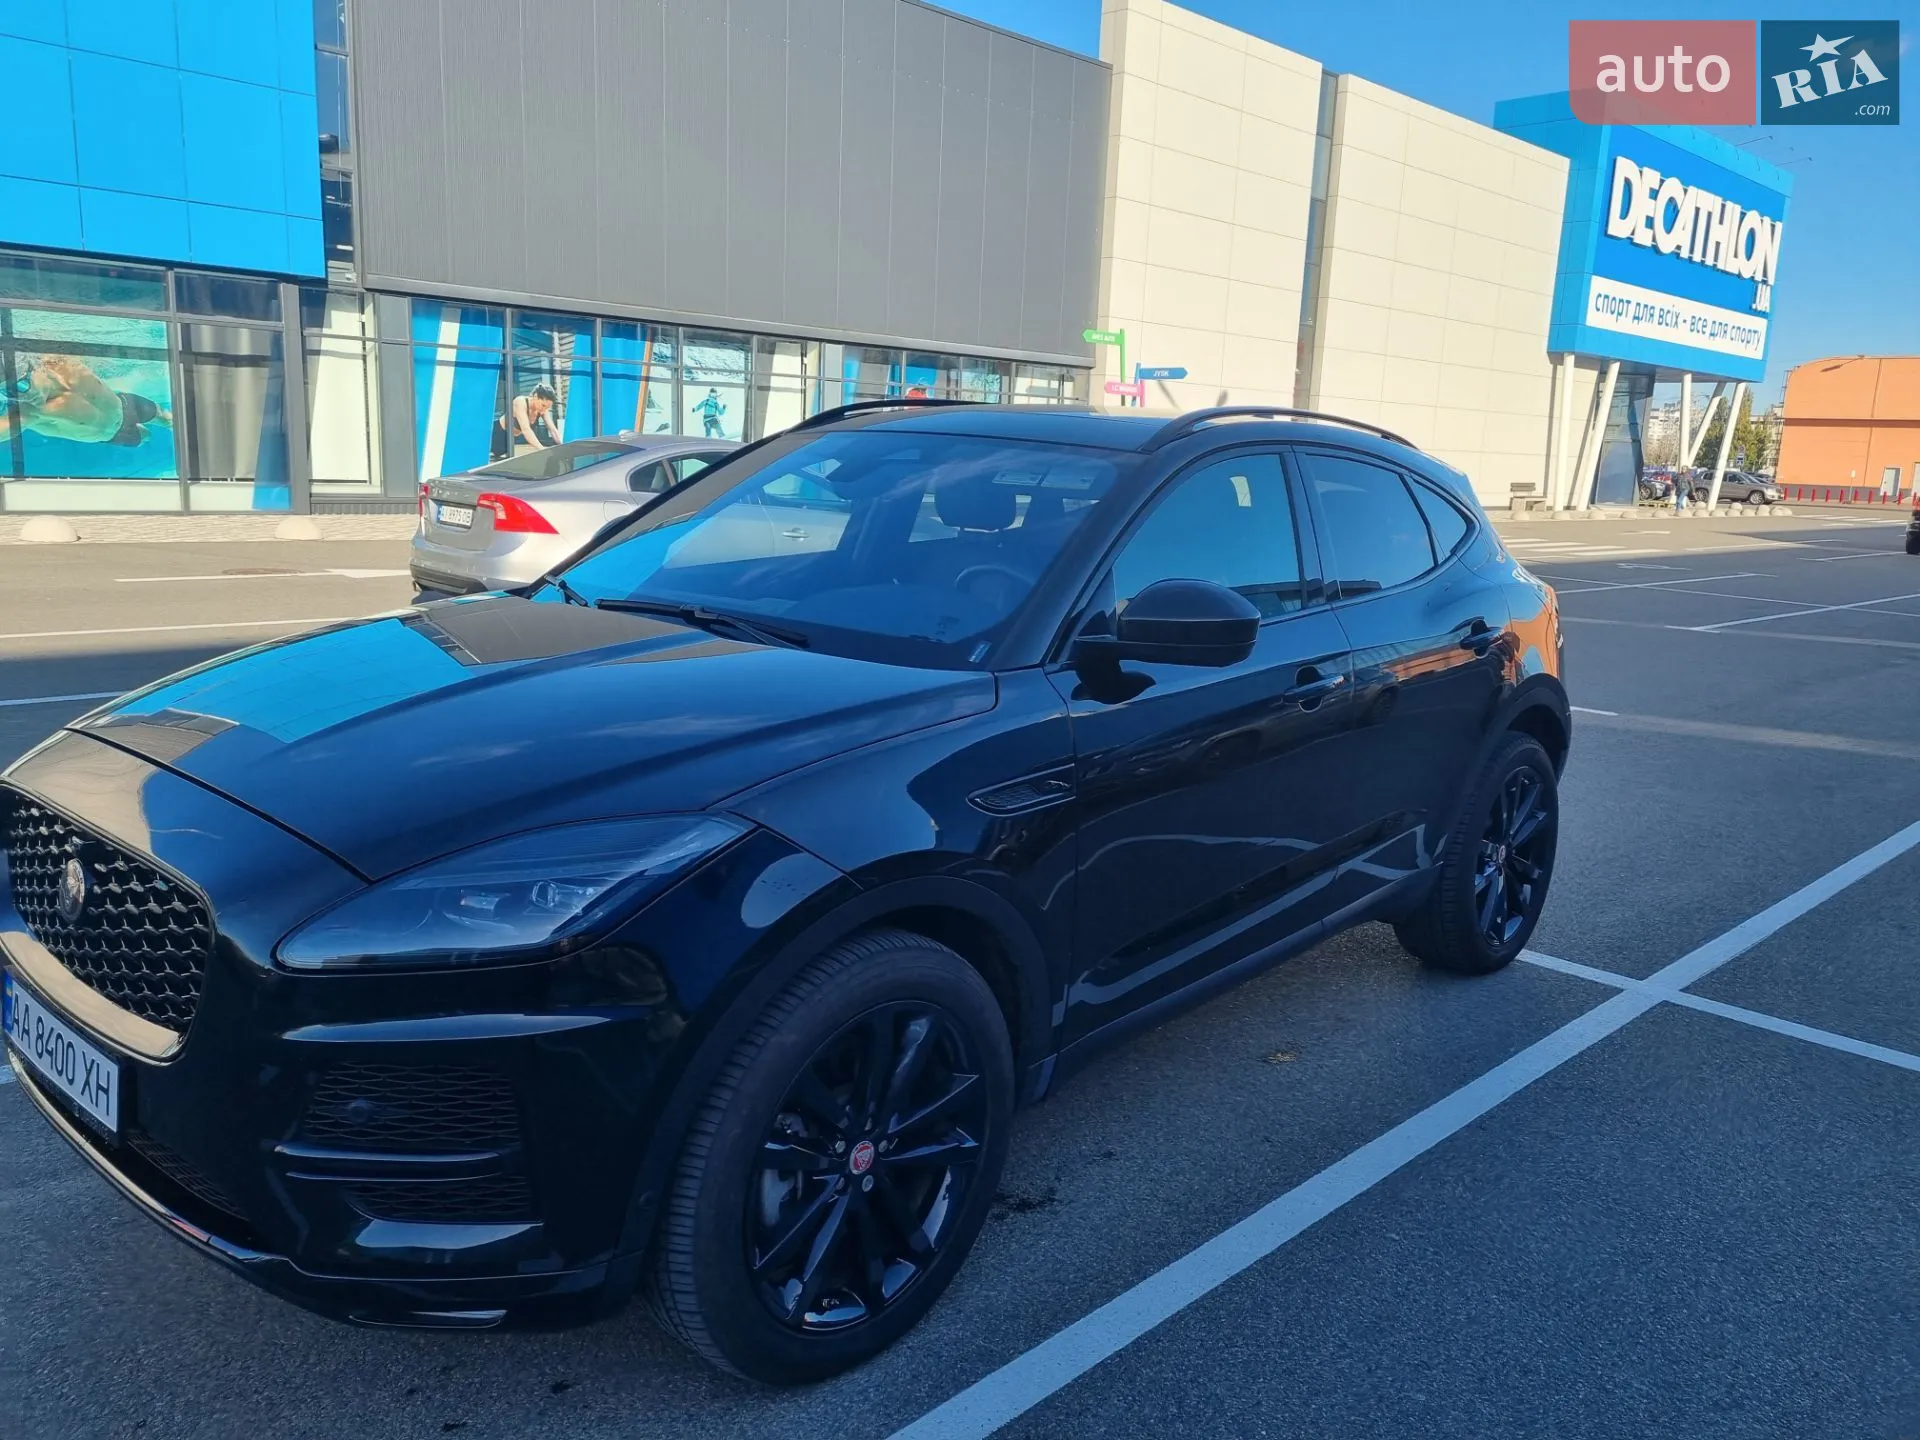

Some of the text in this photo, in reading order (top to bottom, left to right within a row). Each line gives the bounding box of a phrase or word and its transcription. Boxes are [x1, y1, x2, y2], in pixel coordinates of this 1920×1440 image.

[1606, 155, 1783, 286] DECATHLON
[1594, 292, 1632, 324] спорт
[1632, 301, 1656, 325] для
[1657, 304, 1681, 329] всіх
[1689, 315, 1708, 335] все
[1708, 320, 1729, 341] для
[1729, 324, 1763, 352] спорту
[12, 993, 111, 1117] AA 8400 XH
